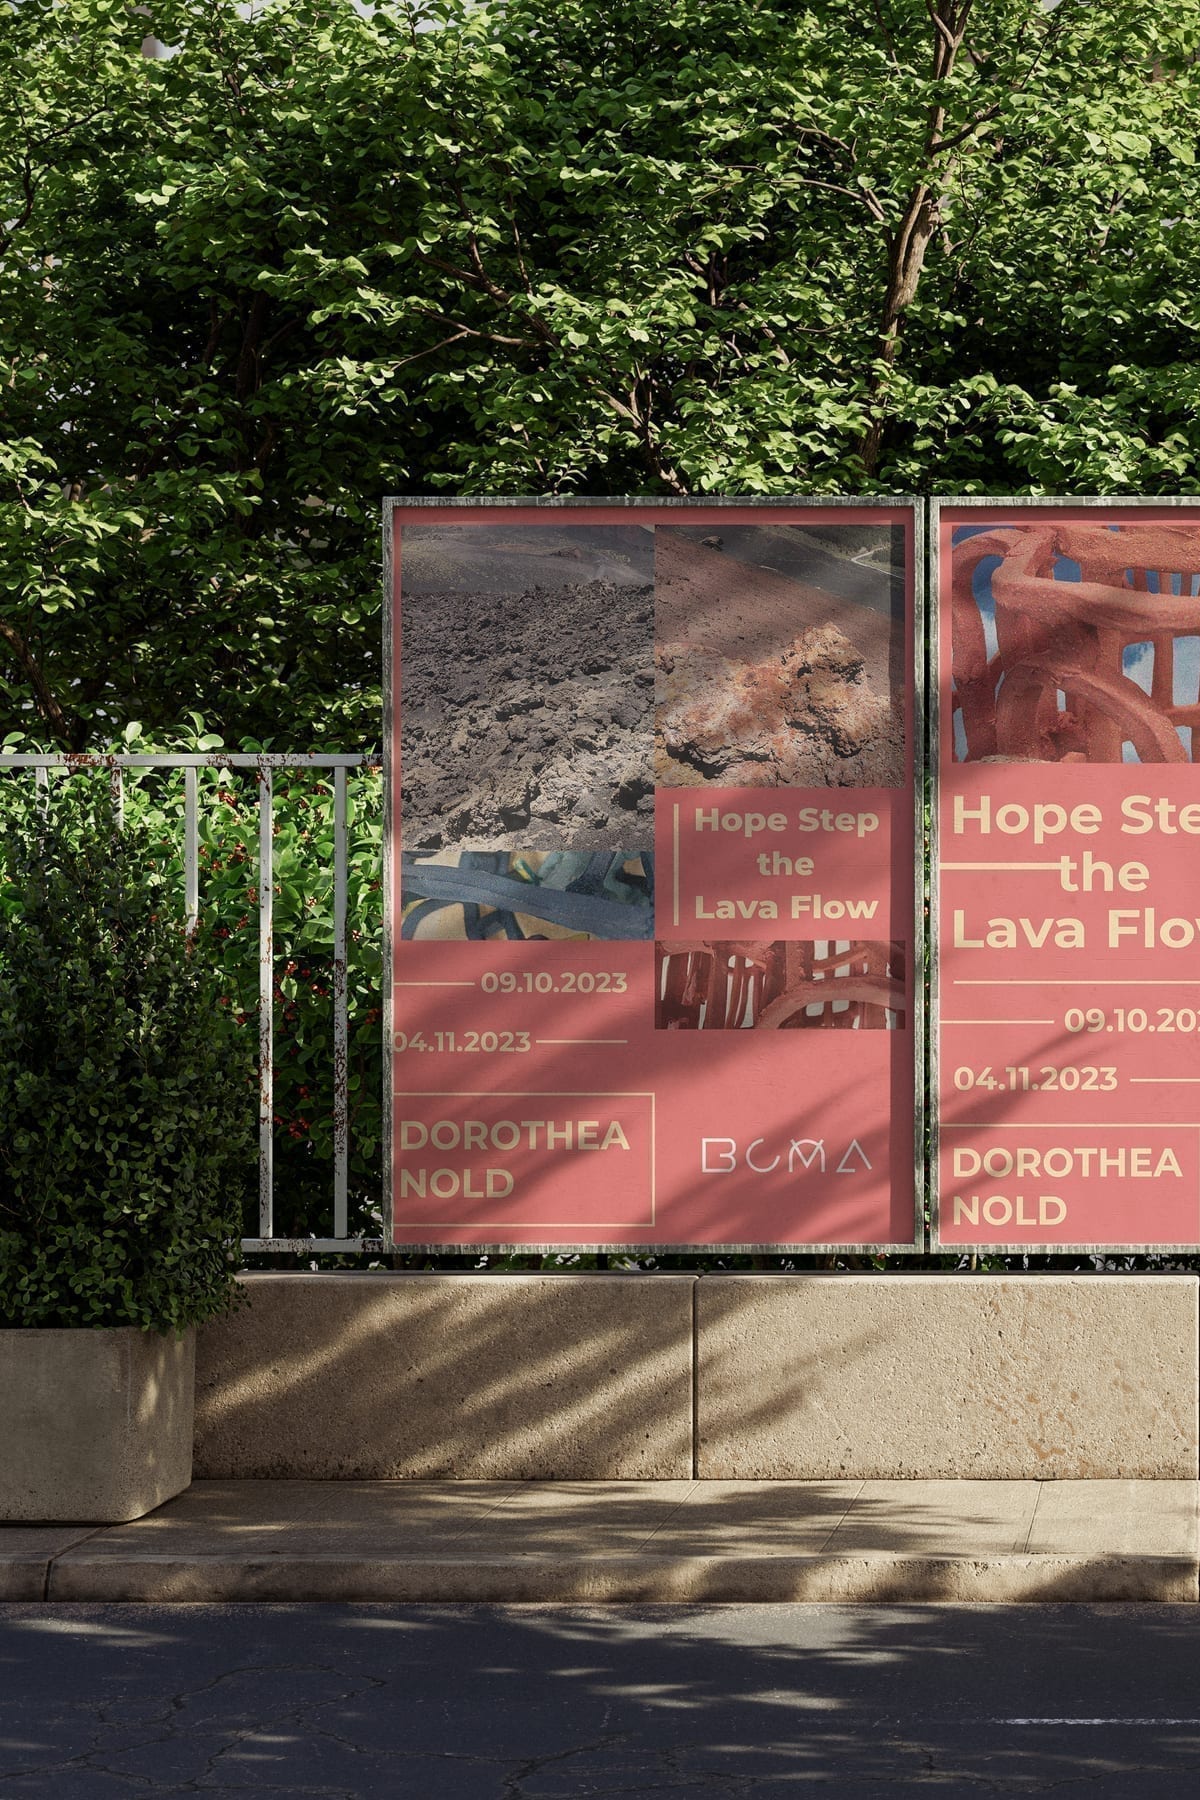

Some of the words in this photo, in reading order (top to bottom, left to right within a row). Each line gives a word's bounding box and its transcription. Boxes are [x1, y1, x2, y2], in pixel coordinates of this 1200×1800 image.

[695, 808, 787, 838] Hope
[798, 808, 879, 838] Step
[953, 795, 1103, 844] Hope
[756, 851, 815, 877] the
[1058, 851, 1150, 893] the
[695, 896, 778, 919] Lava
[791, 895, 879, 919] Flow
[953, 909, 1086, 949] Lava
[480, 972, 628, 994] 09.10.2023
[393, 1031, 531, 1053] 04.11.2023
[953, 1067, 1118, 1091] 04.11.2023
[400, 1120, 630, 1151] DOROTHEA
[953, 1147, 1183, 1178] DOROTHEA
[400, 1168, 514, 1199] NOLD
[953, 1195, 1067, 1226] NOLD
